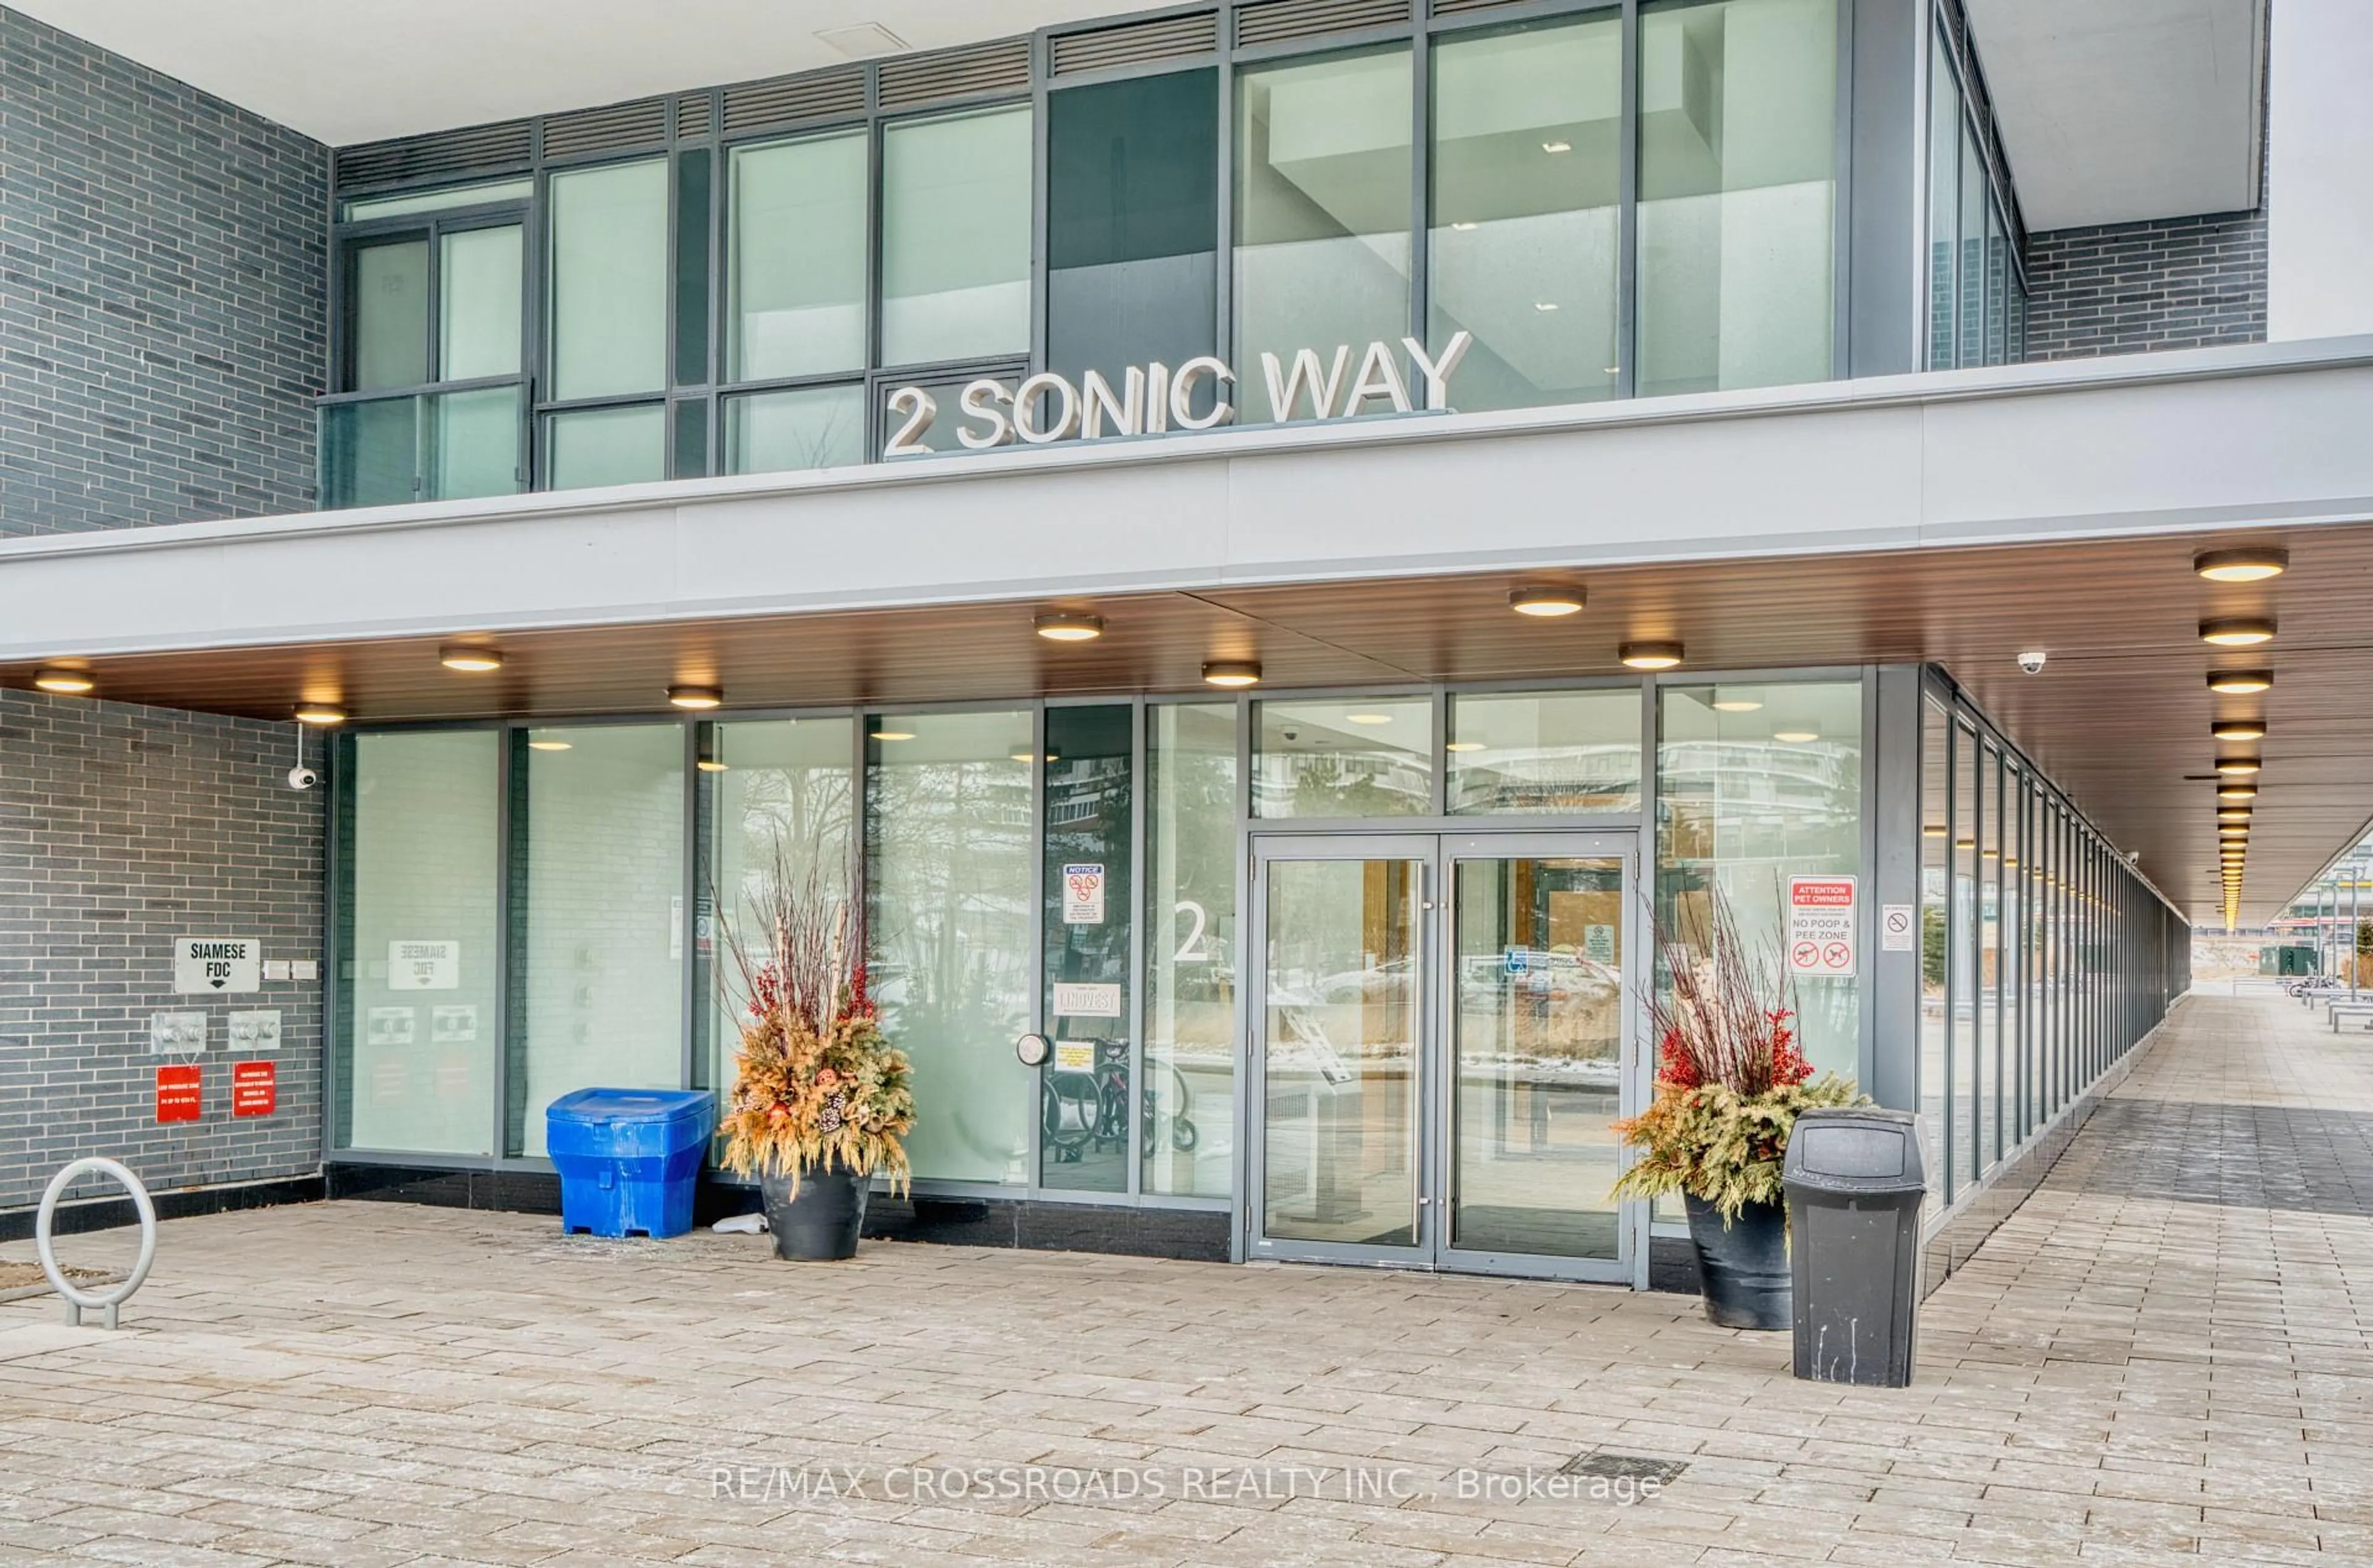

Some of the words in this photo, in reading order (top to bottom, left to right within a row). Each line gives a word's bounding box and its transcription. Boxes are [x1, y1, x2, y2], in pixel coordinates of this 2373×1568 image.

[884, 387, 937, 457] 2
[957, 356, 1236, 449] SONIC
[1261, 331, 1473, 423] WAY
[1799, 887, 1846, 895] ATTENTION
[1173, 901, 1208, 961] 2
[1793, 919, 1808, 928] NO
[1810, 919, 1840, 928] POOP
[1843, 919, 1850, 928] &
[1795, 930, 1816, 939] PEE
[1818, 930, 1848, 940] ZONE
[190, 943, 247, 959] SIAMESE
[206, 962, 231, 977] FDC
